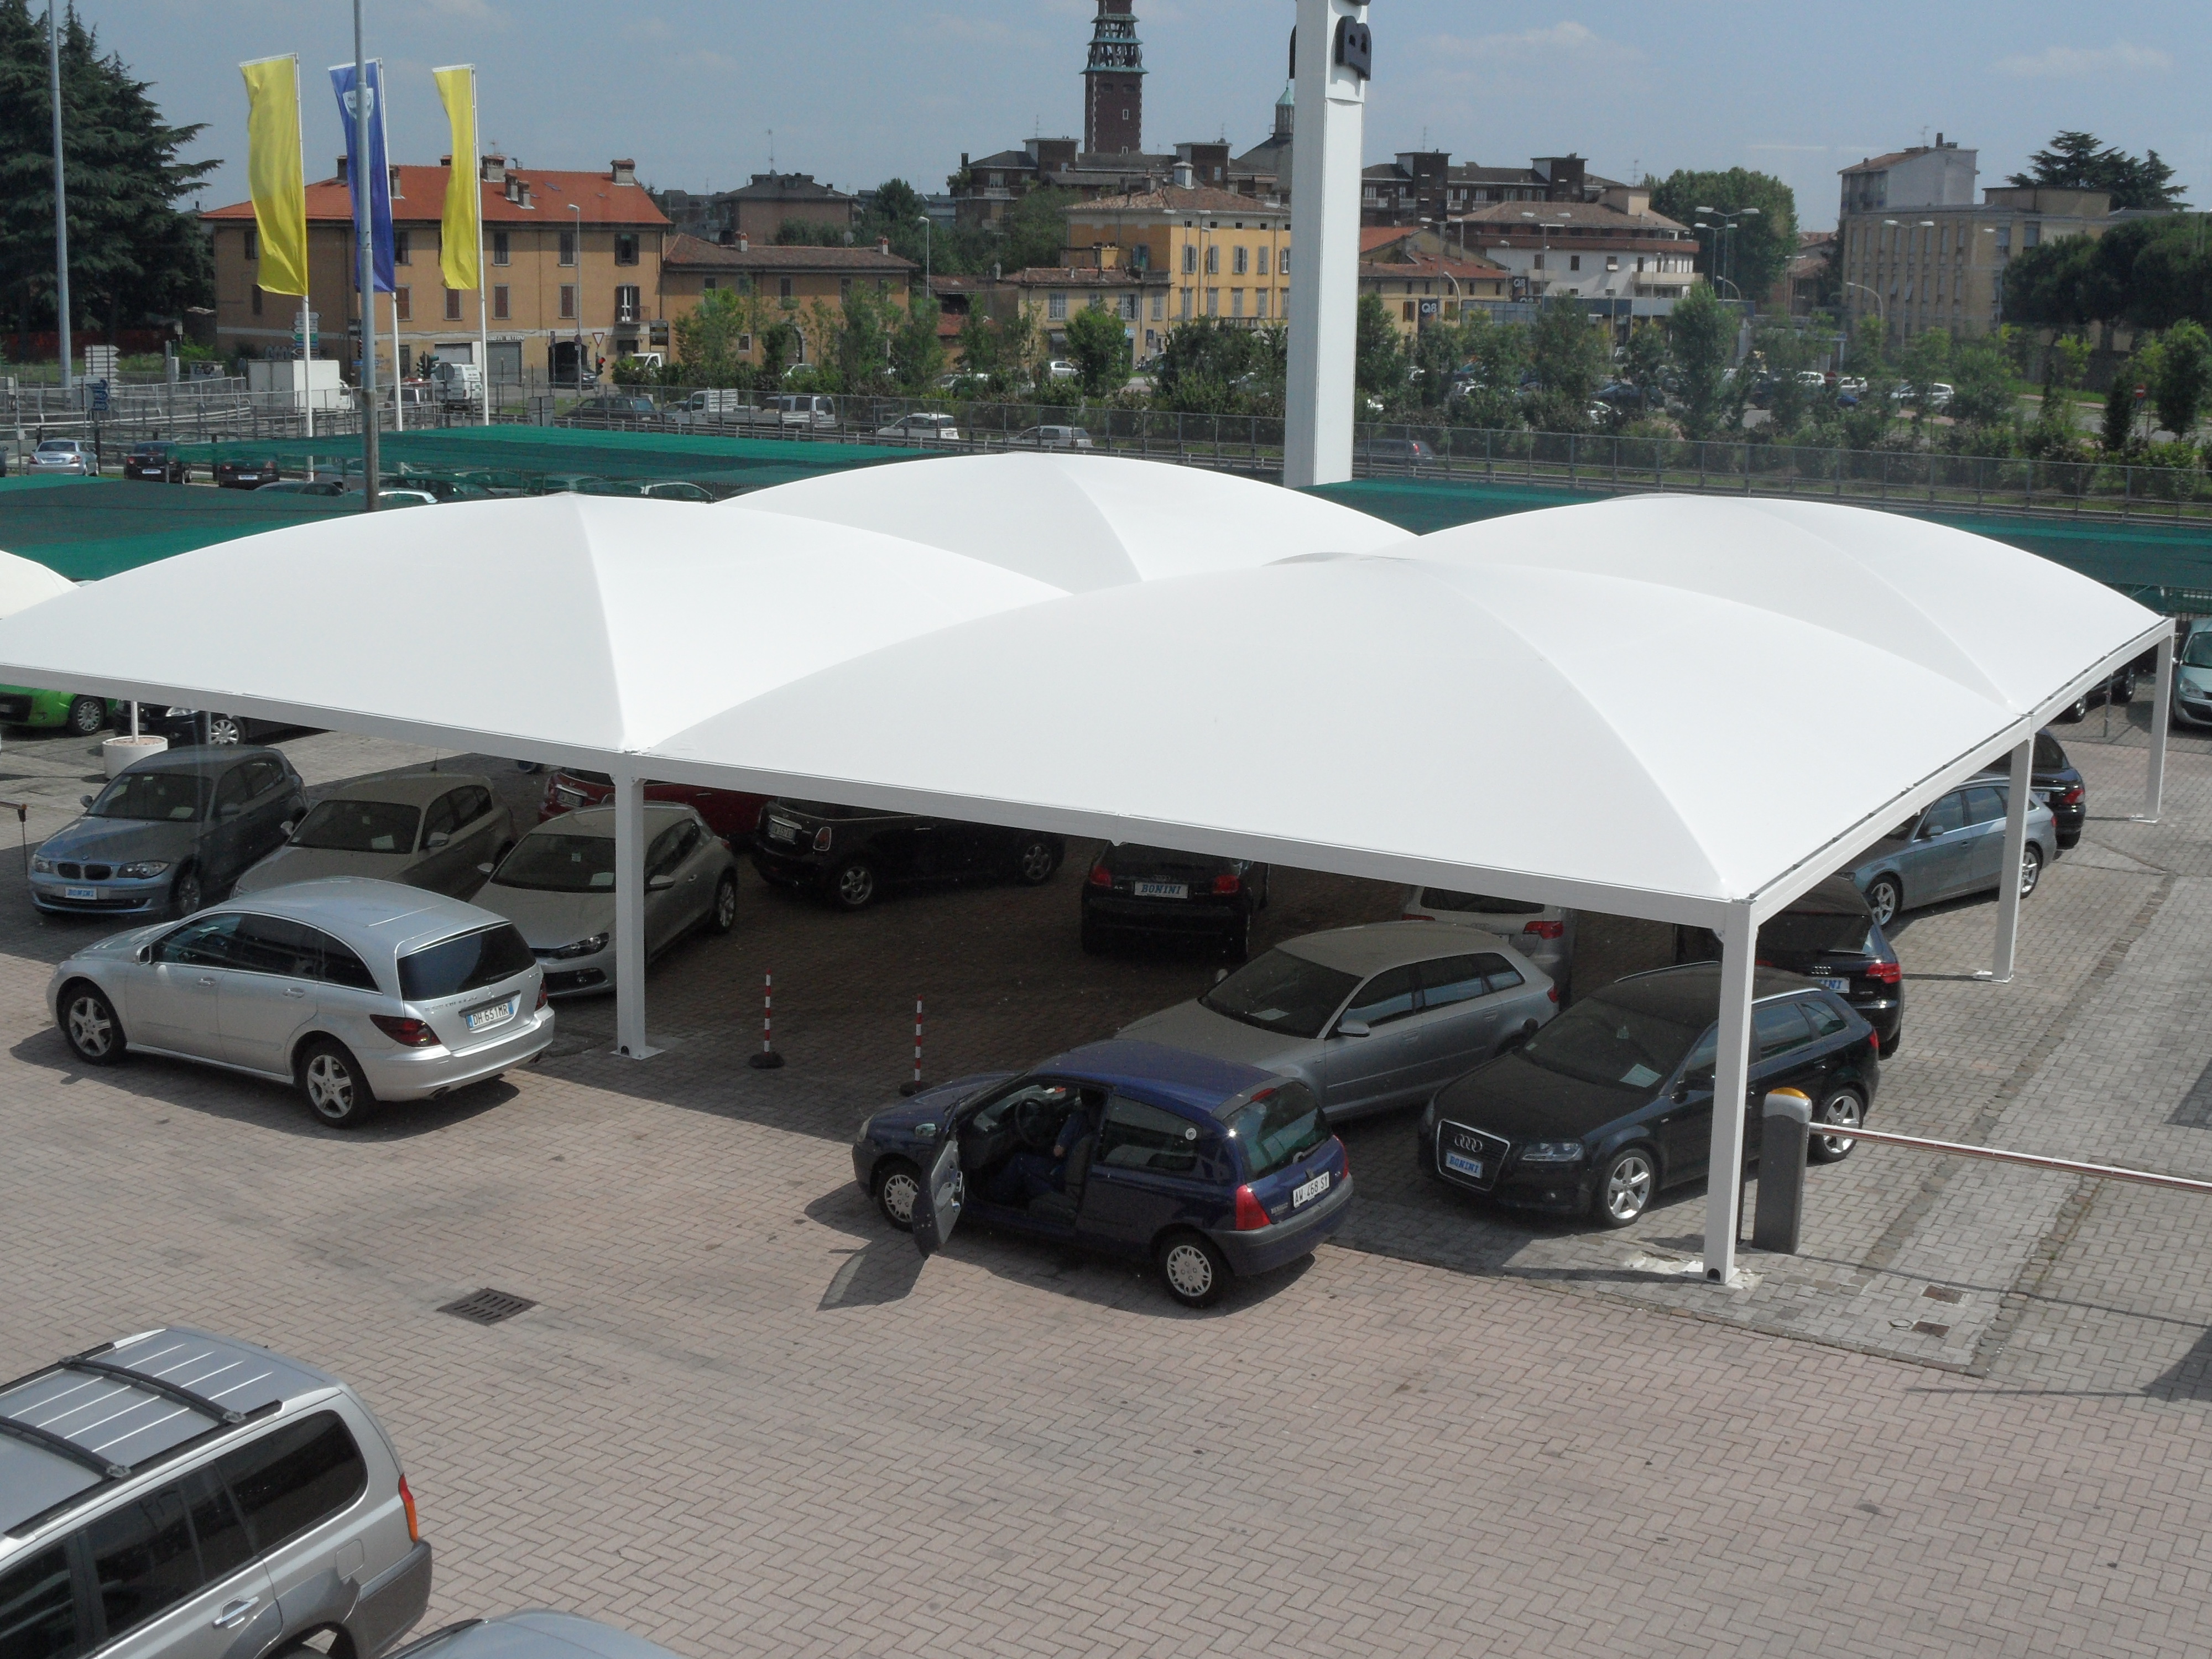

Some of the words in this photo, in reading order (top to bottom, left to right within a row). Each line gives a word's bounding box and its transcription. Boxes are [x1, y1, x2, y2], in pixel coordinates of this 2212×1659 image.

[1514, 279, 1526, 288] Q8
[1421, 302, 1437, 314] Q8
[1141, 884, 1182, 894] BONINI
[473, 1011, 483, 1025] DH
[1306, 1180, 1318, 1197] 468
[1320, 1175, 1328, 1190] SY
